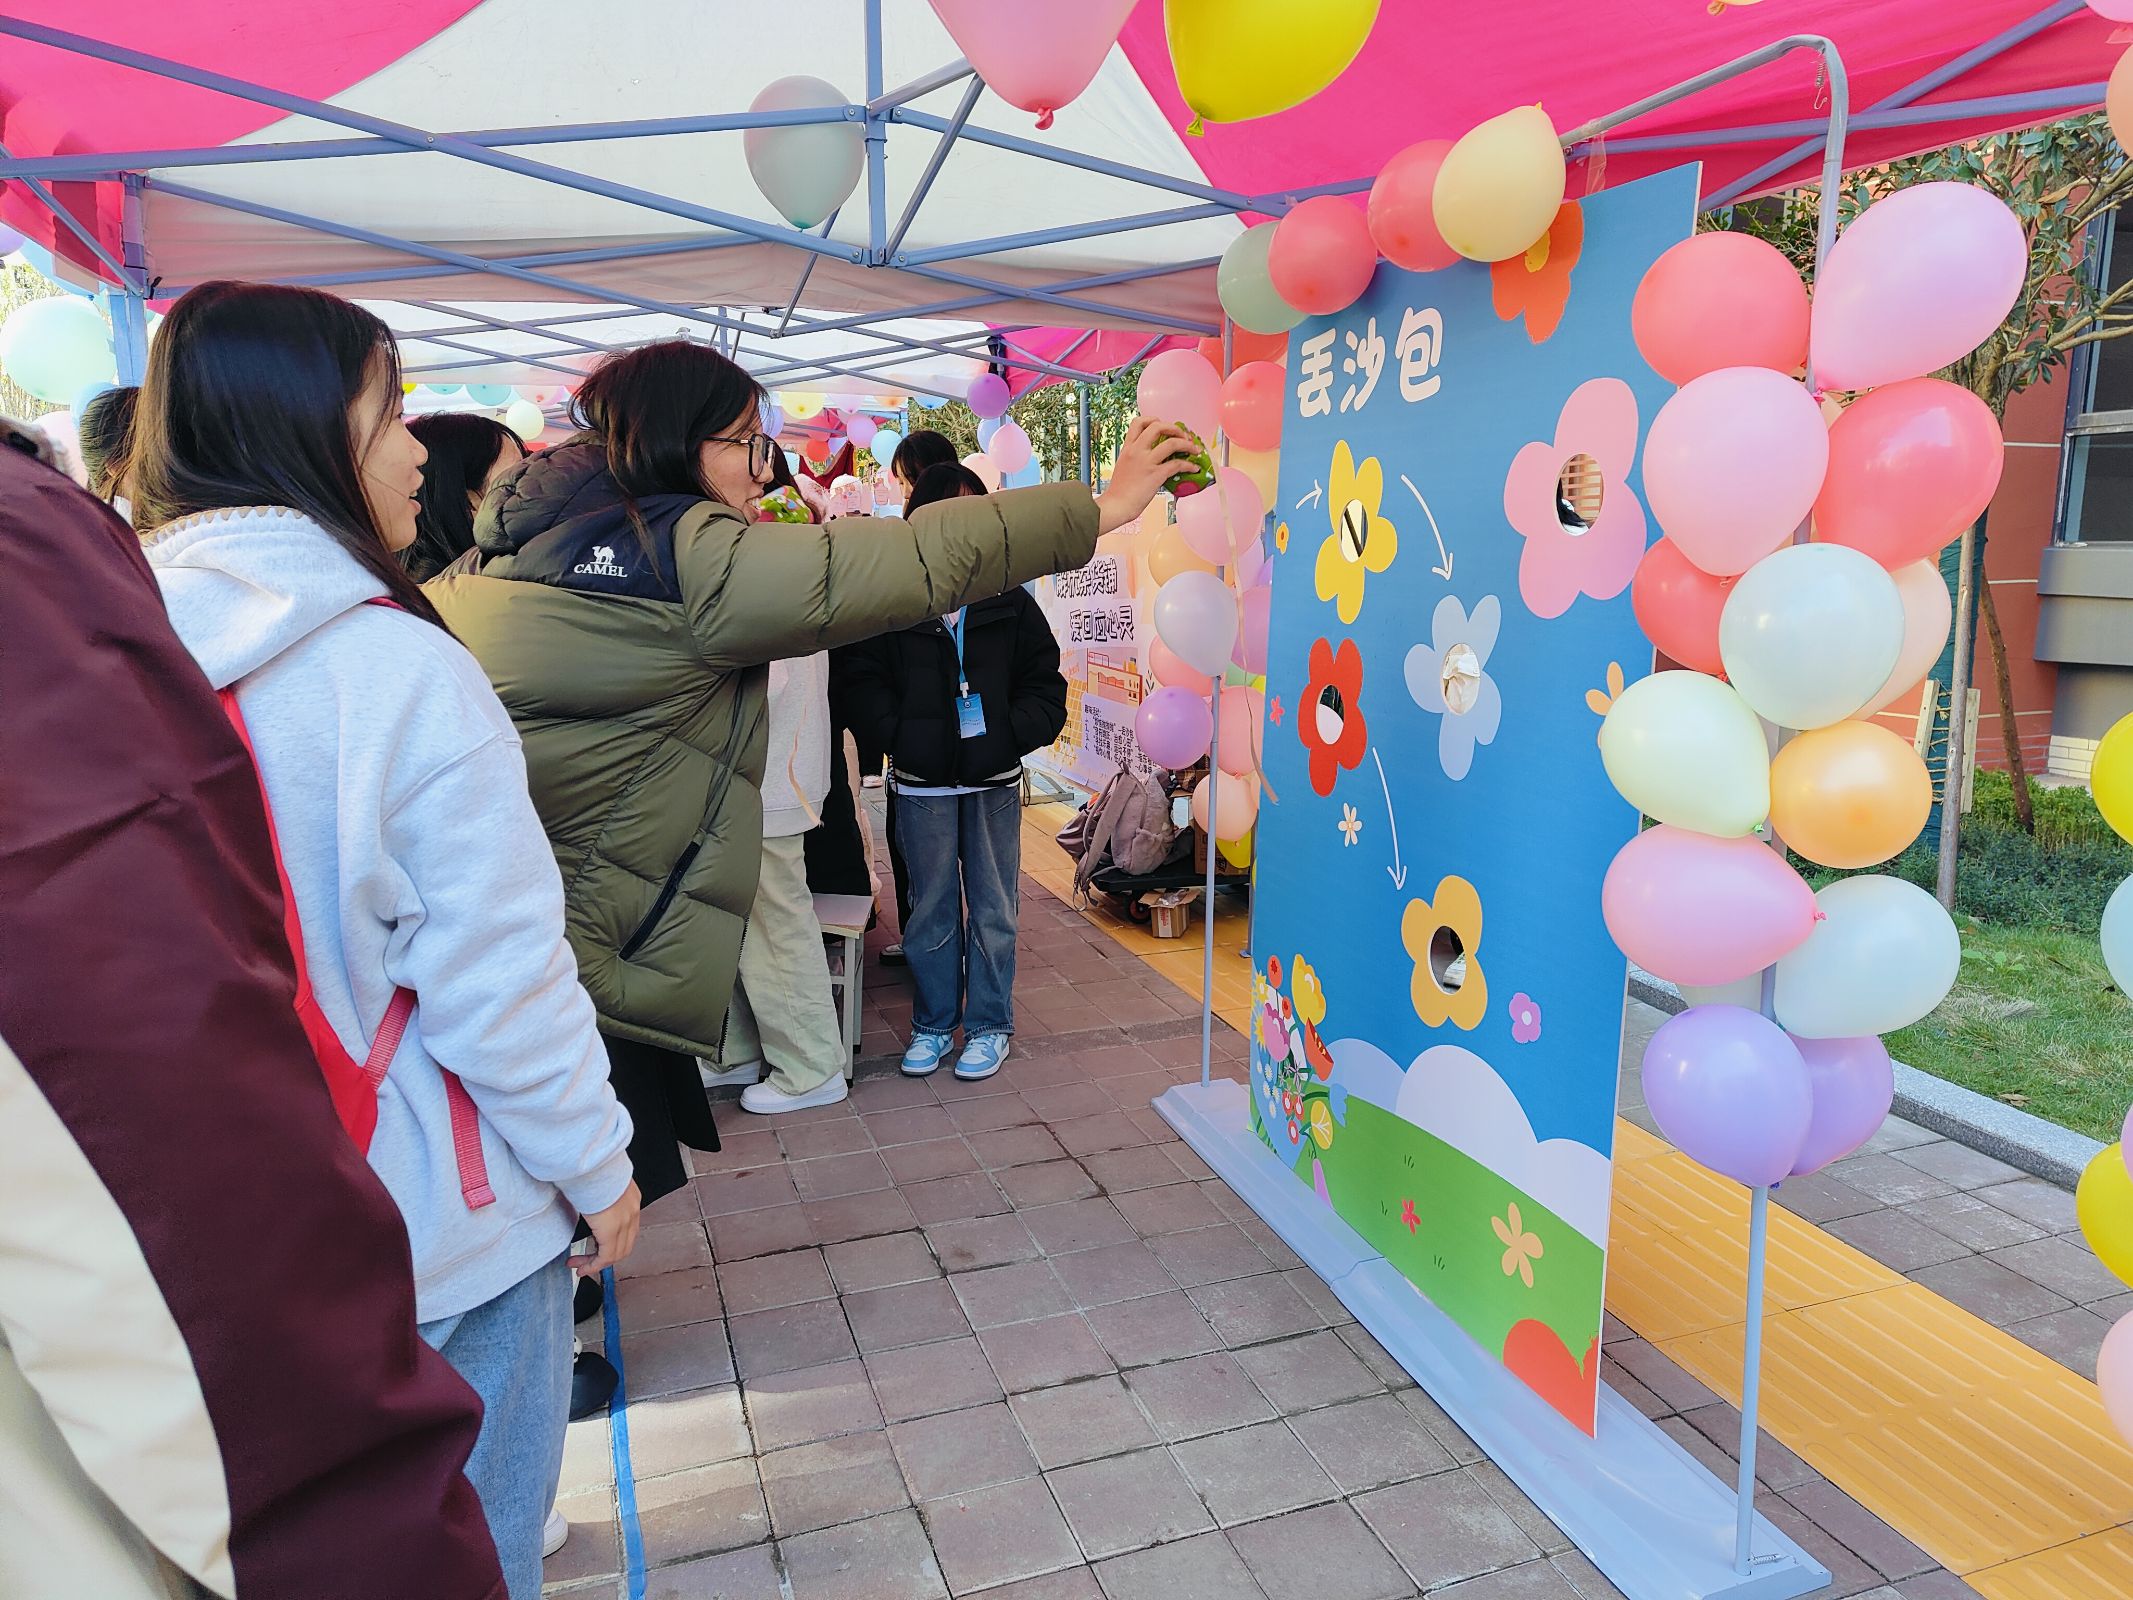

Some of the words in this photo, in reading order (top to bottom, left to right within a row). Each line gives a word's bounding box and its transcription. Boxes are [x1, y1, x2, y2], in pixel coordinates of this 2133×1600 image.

[1297, 306, 1443, 418] 丢沙包
[574, 563, 628, 577] CAMEL
